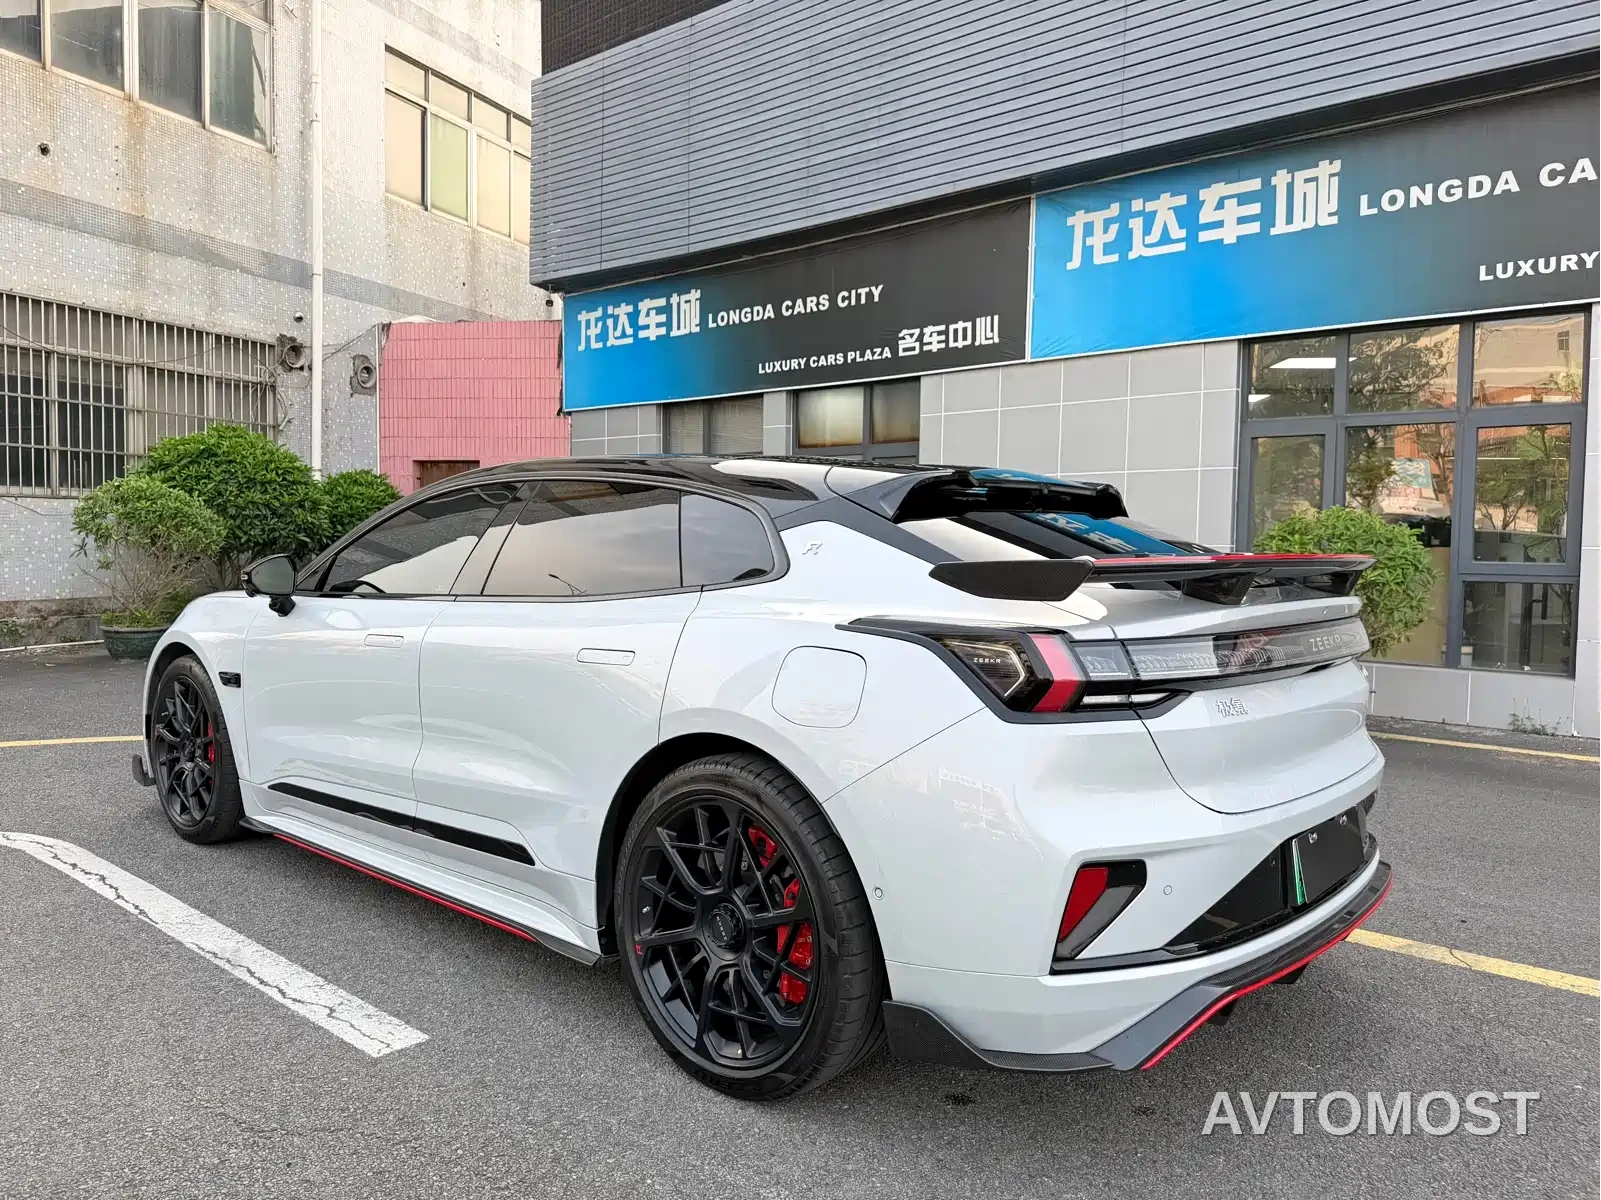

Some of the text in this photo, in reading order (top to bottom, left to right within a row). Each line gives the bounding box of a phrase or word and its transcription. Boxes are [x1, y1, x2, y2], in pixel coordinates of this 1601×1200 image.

[1066, 158, 1342, 271] 龙达车城
[1359, 169, 1521, 217] LONGDA
[1479, 250, 1600, 282] LUXURY
[577, 289, 702, 352] 龙达车城
[707, 284, 884, 329] LONGDA CARS CITY
[897, 314, 1000, 358] 名车中心
[758, 346, 892, 375] LUXURY CARS PLAZA
[1309, 634, 1342, 652] ZEEKR
